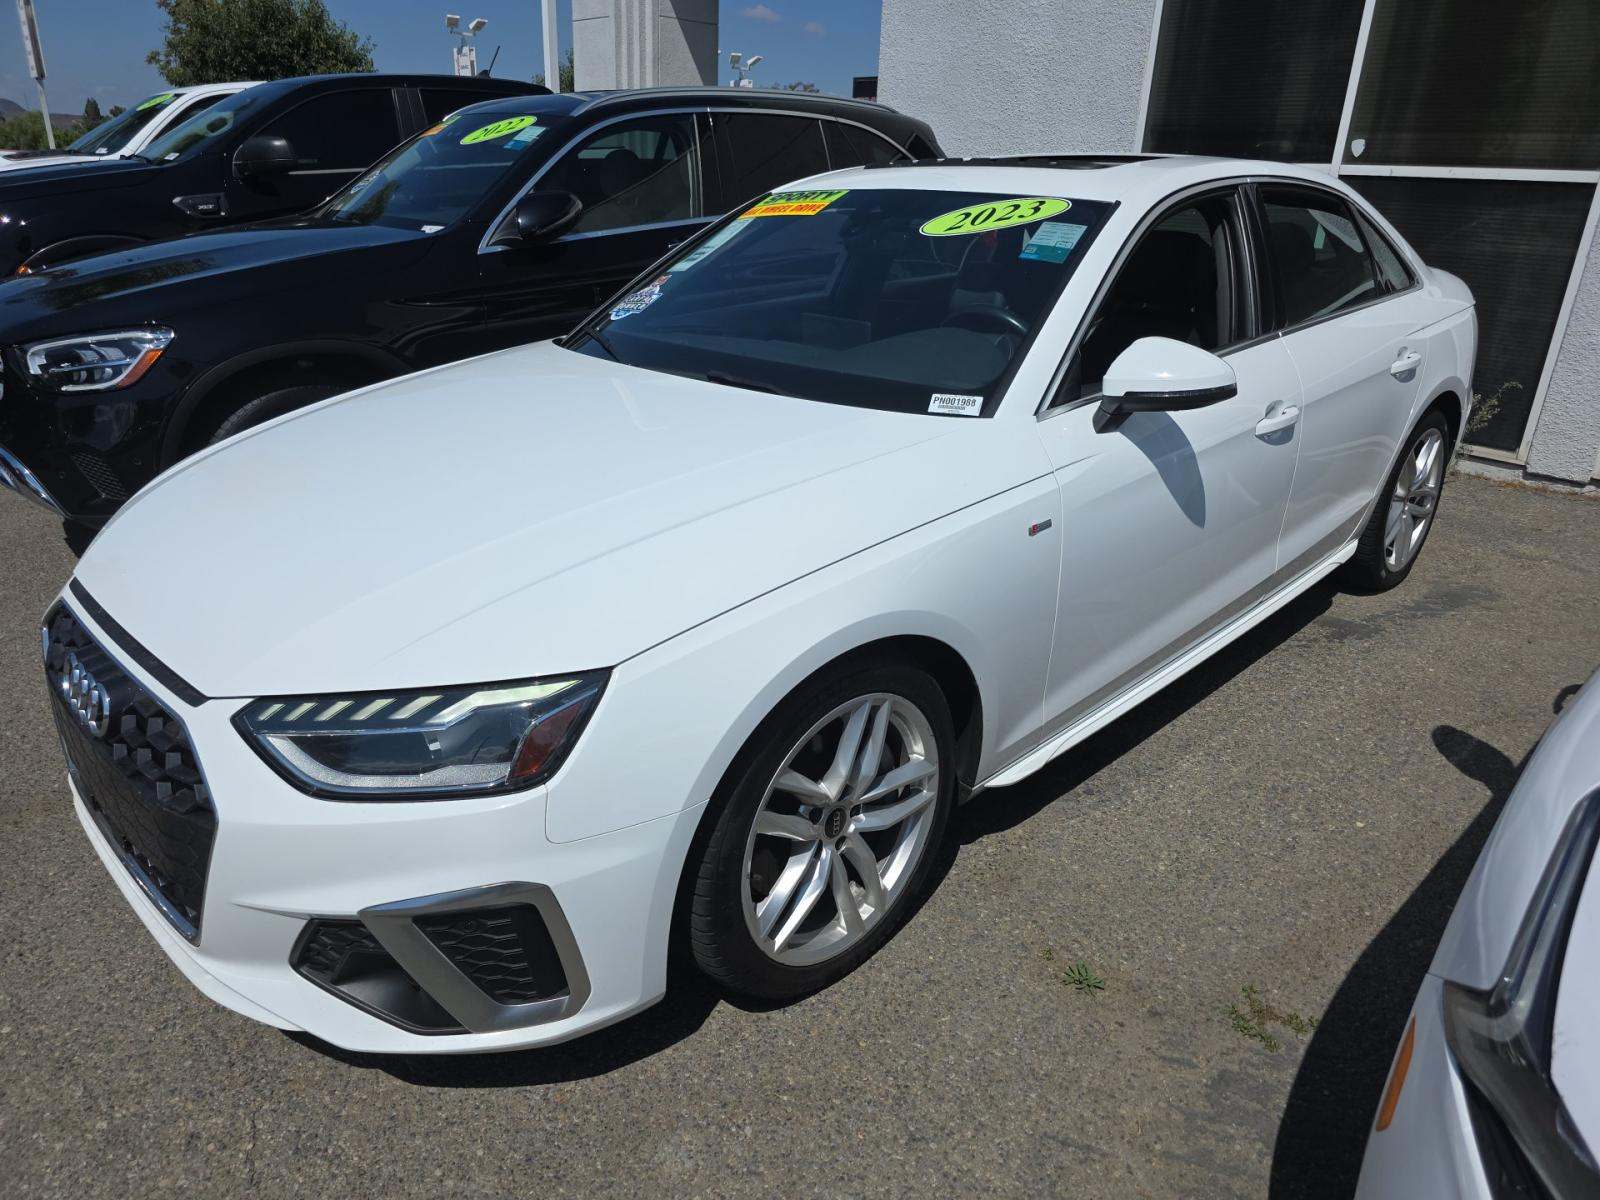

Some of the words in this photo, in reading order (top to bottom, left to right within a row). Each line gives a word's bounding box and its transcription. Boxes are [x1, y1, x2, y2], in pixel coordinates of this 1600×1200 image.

[470, 118, 526, 141] 2022
[762, 189, 845, 205] SPORTY
[759, 204, 796, 214] WHEEL
[789, 203, 827, 213] DRIVE
[943, 200, 1047, 232] 2023
[933, 396, 977, 407] PN001988
